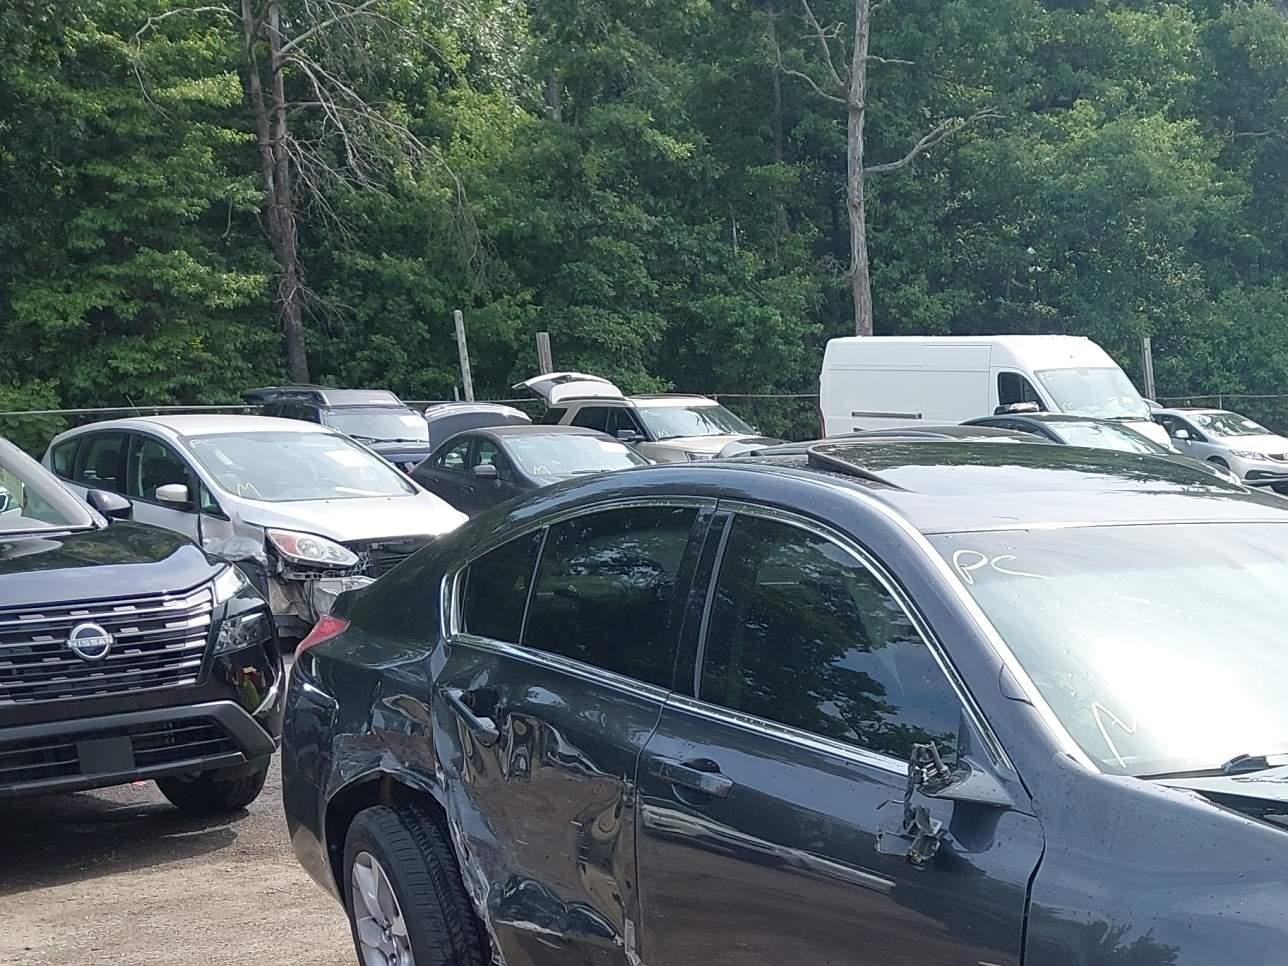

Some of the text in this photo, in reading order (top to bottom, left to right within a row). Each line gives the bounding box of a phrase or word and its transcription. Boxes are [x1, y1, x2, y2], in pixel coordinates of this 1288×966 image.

[237, 482, 264, 497] M
[952, 549, 1055, 585] PC
[67, 634, 113, 648] NISSAN
